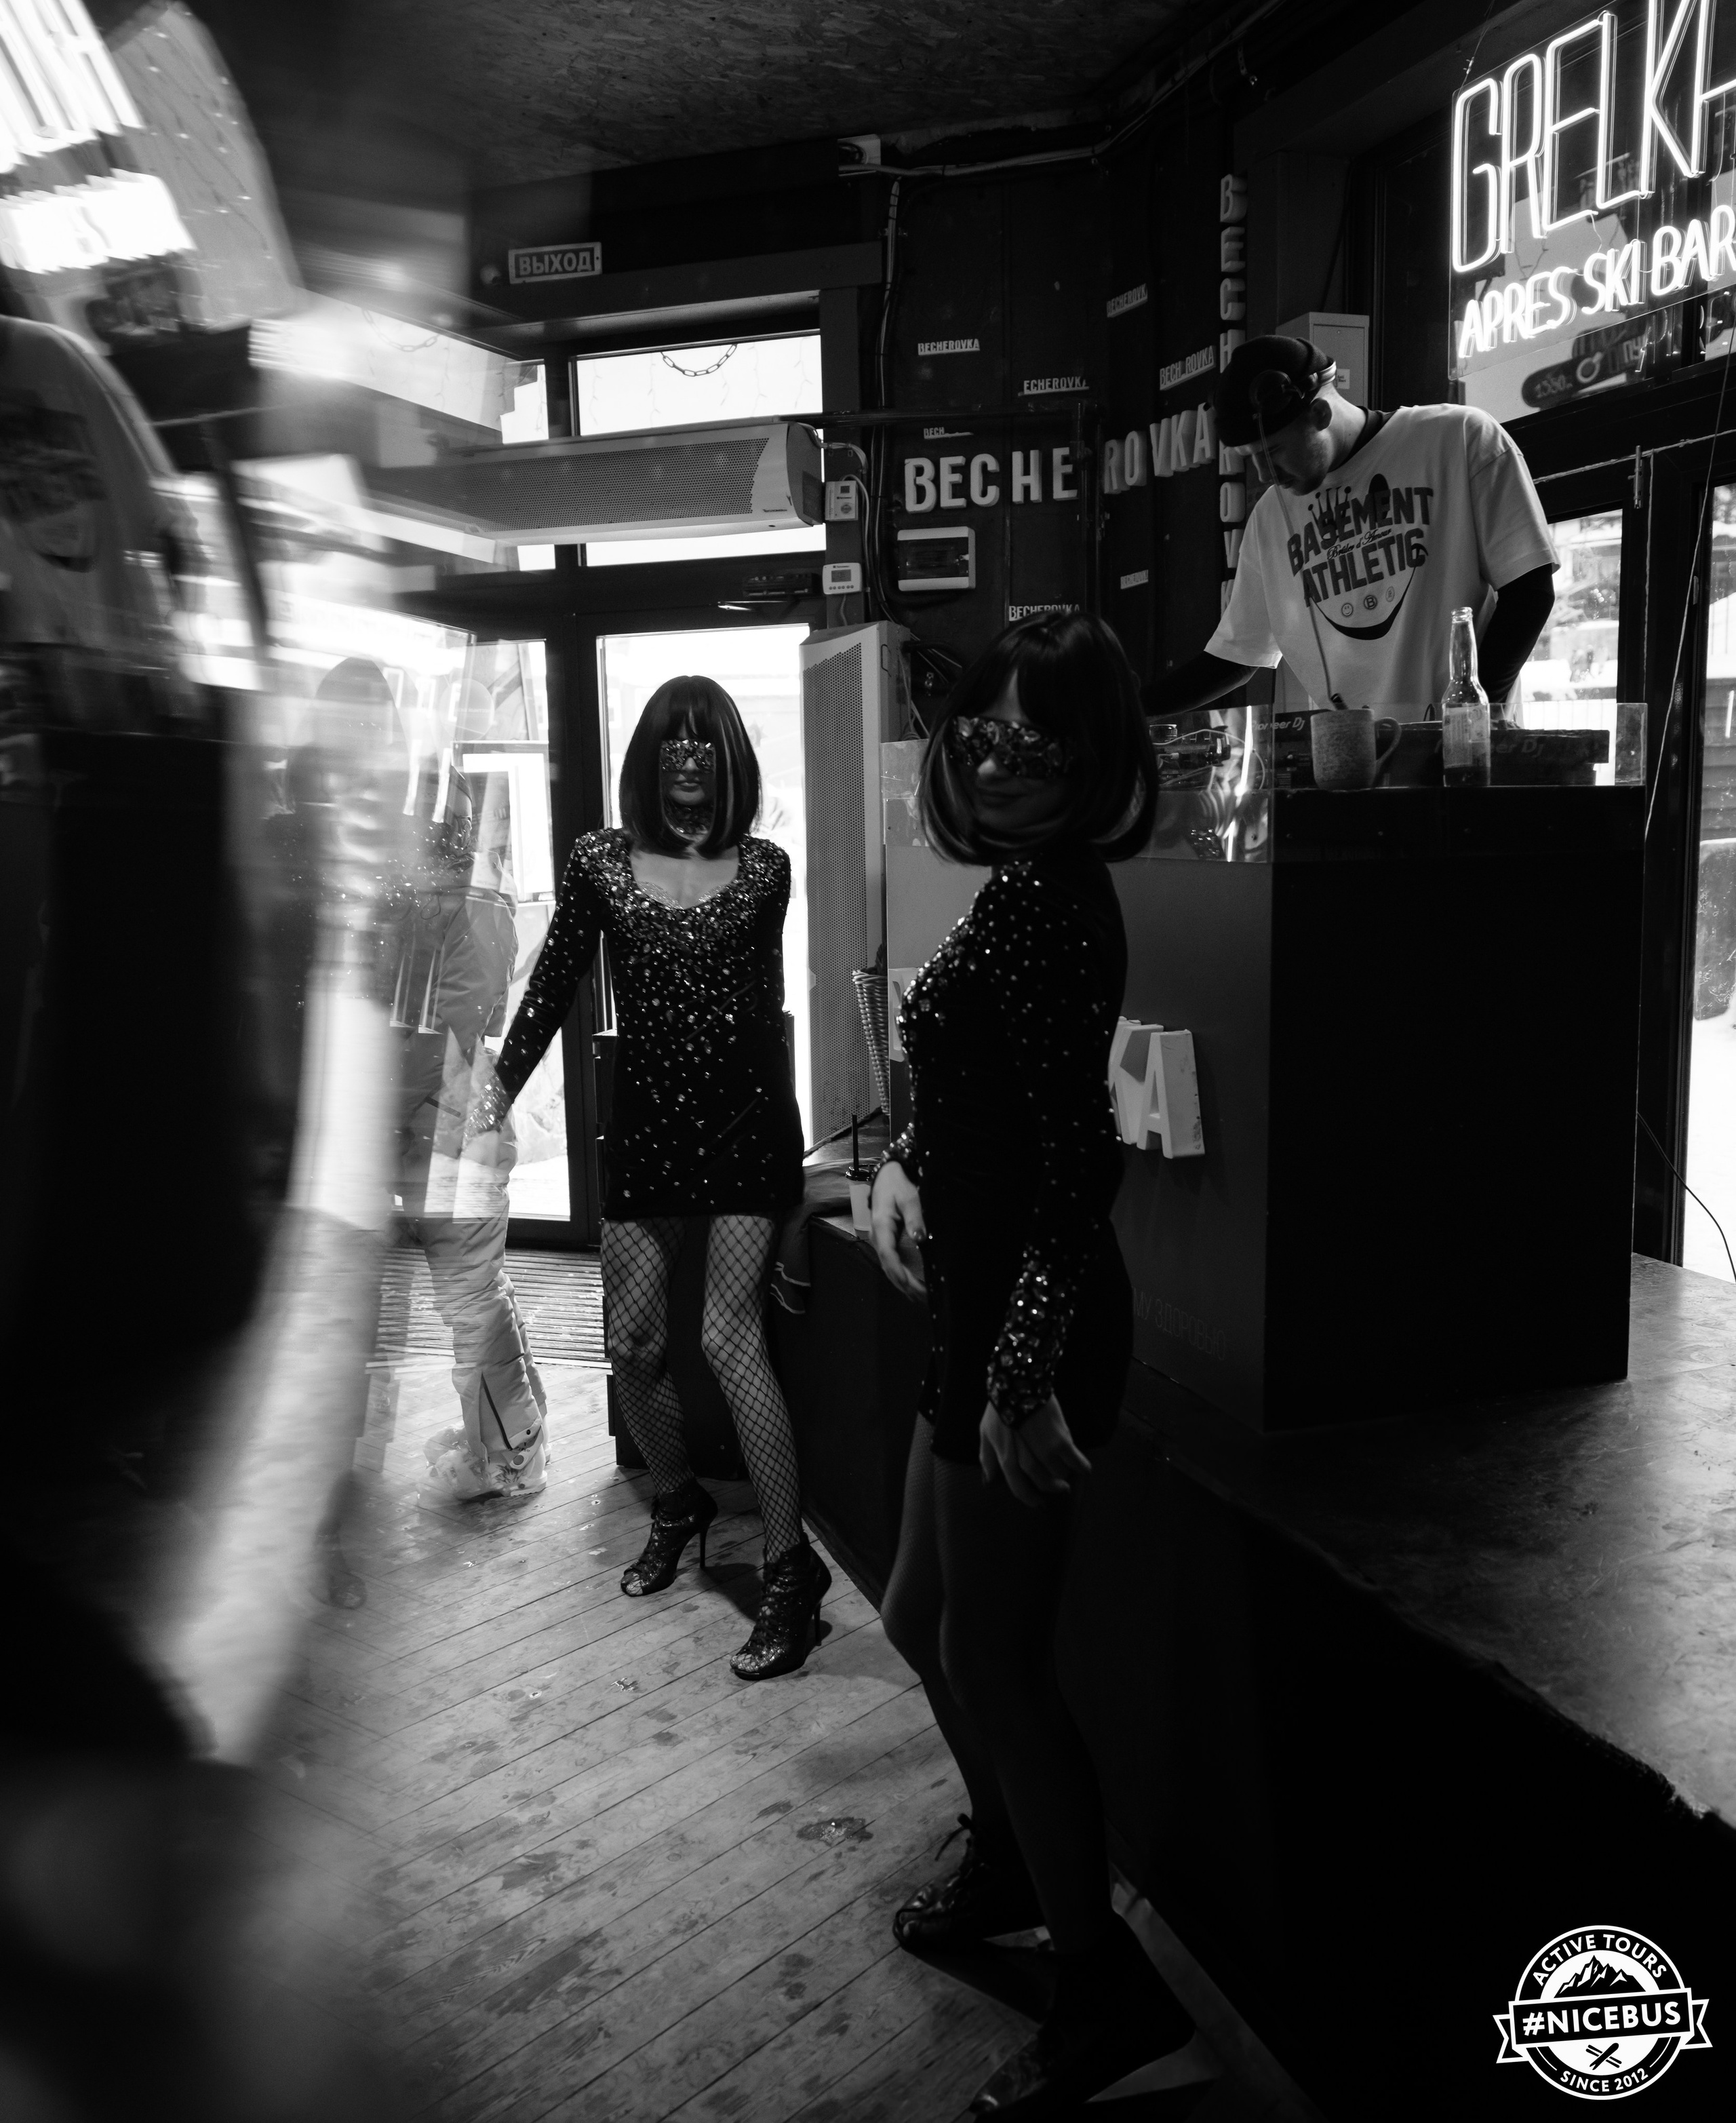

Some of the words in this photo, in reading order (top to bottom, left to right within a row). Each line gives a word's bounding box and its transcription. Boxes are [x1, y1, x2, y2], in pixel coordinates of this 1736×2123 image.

[519, 251, 592, 276] ВЫХОД
[1459, 266, 1577, 358] APRES
[1581, 239, 1646, 315] SKI
[1651, 204, 1736, 296] BAR
[1107, 282, 1147, 317] BECHEROVK
[918, 338, 980, 356] BECHEROVKA
[1287, 486, 1434, 577] BASEMENT
[1302, 527, 1426, 608] ATHLETIC
